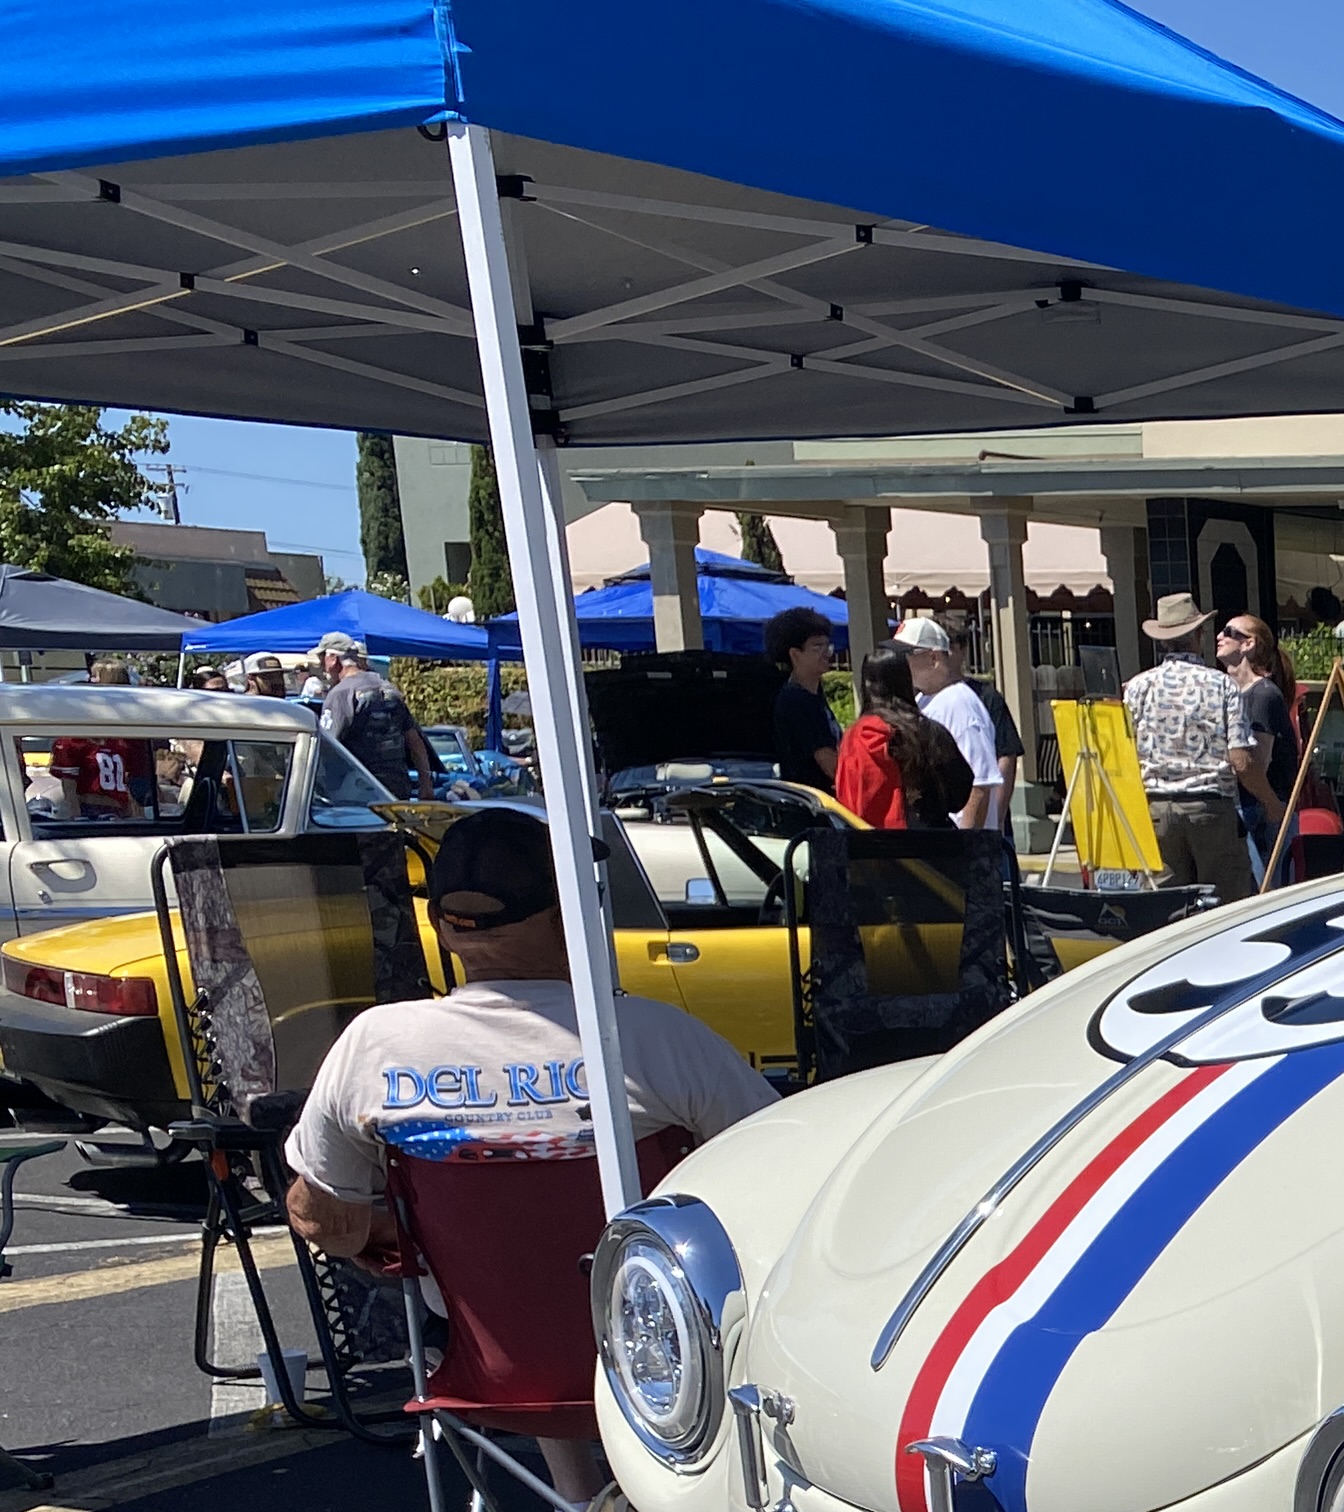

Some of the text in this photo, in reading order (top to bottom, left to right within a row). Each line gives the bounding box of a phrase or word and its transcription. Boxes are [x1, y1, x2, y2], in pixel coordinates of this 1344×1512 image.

[96, 752, 128, 792] 81
[382, 1063, 498, 1110] DEL
[444, 1109, 553, 1124] COUNTRY CLUB
